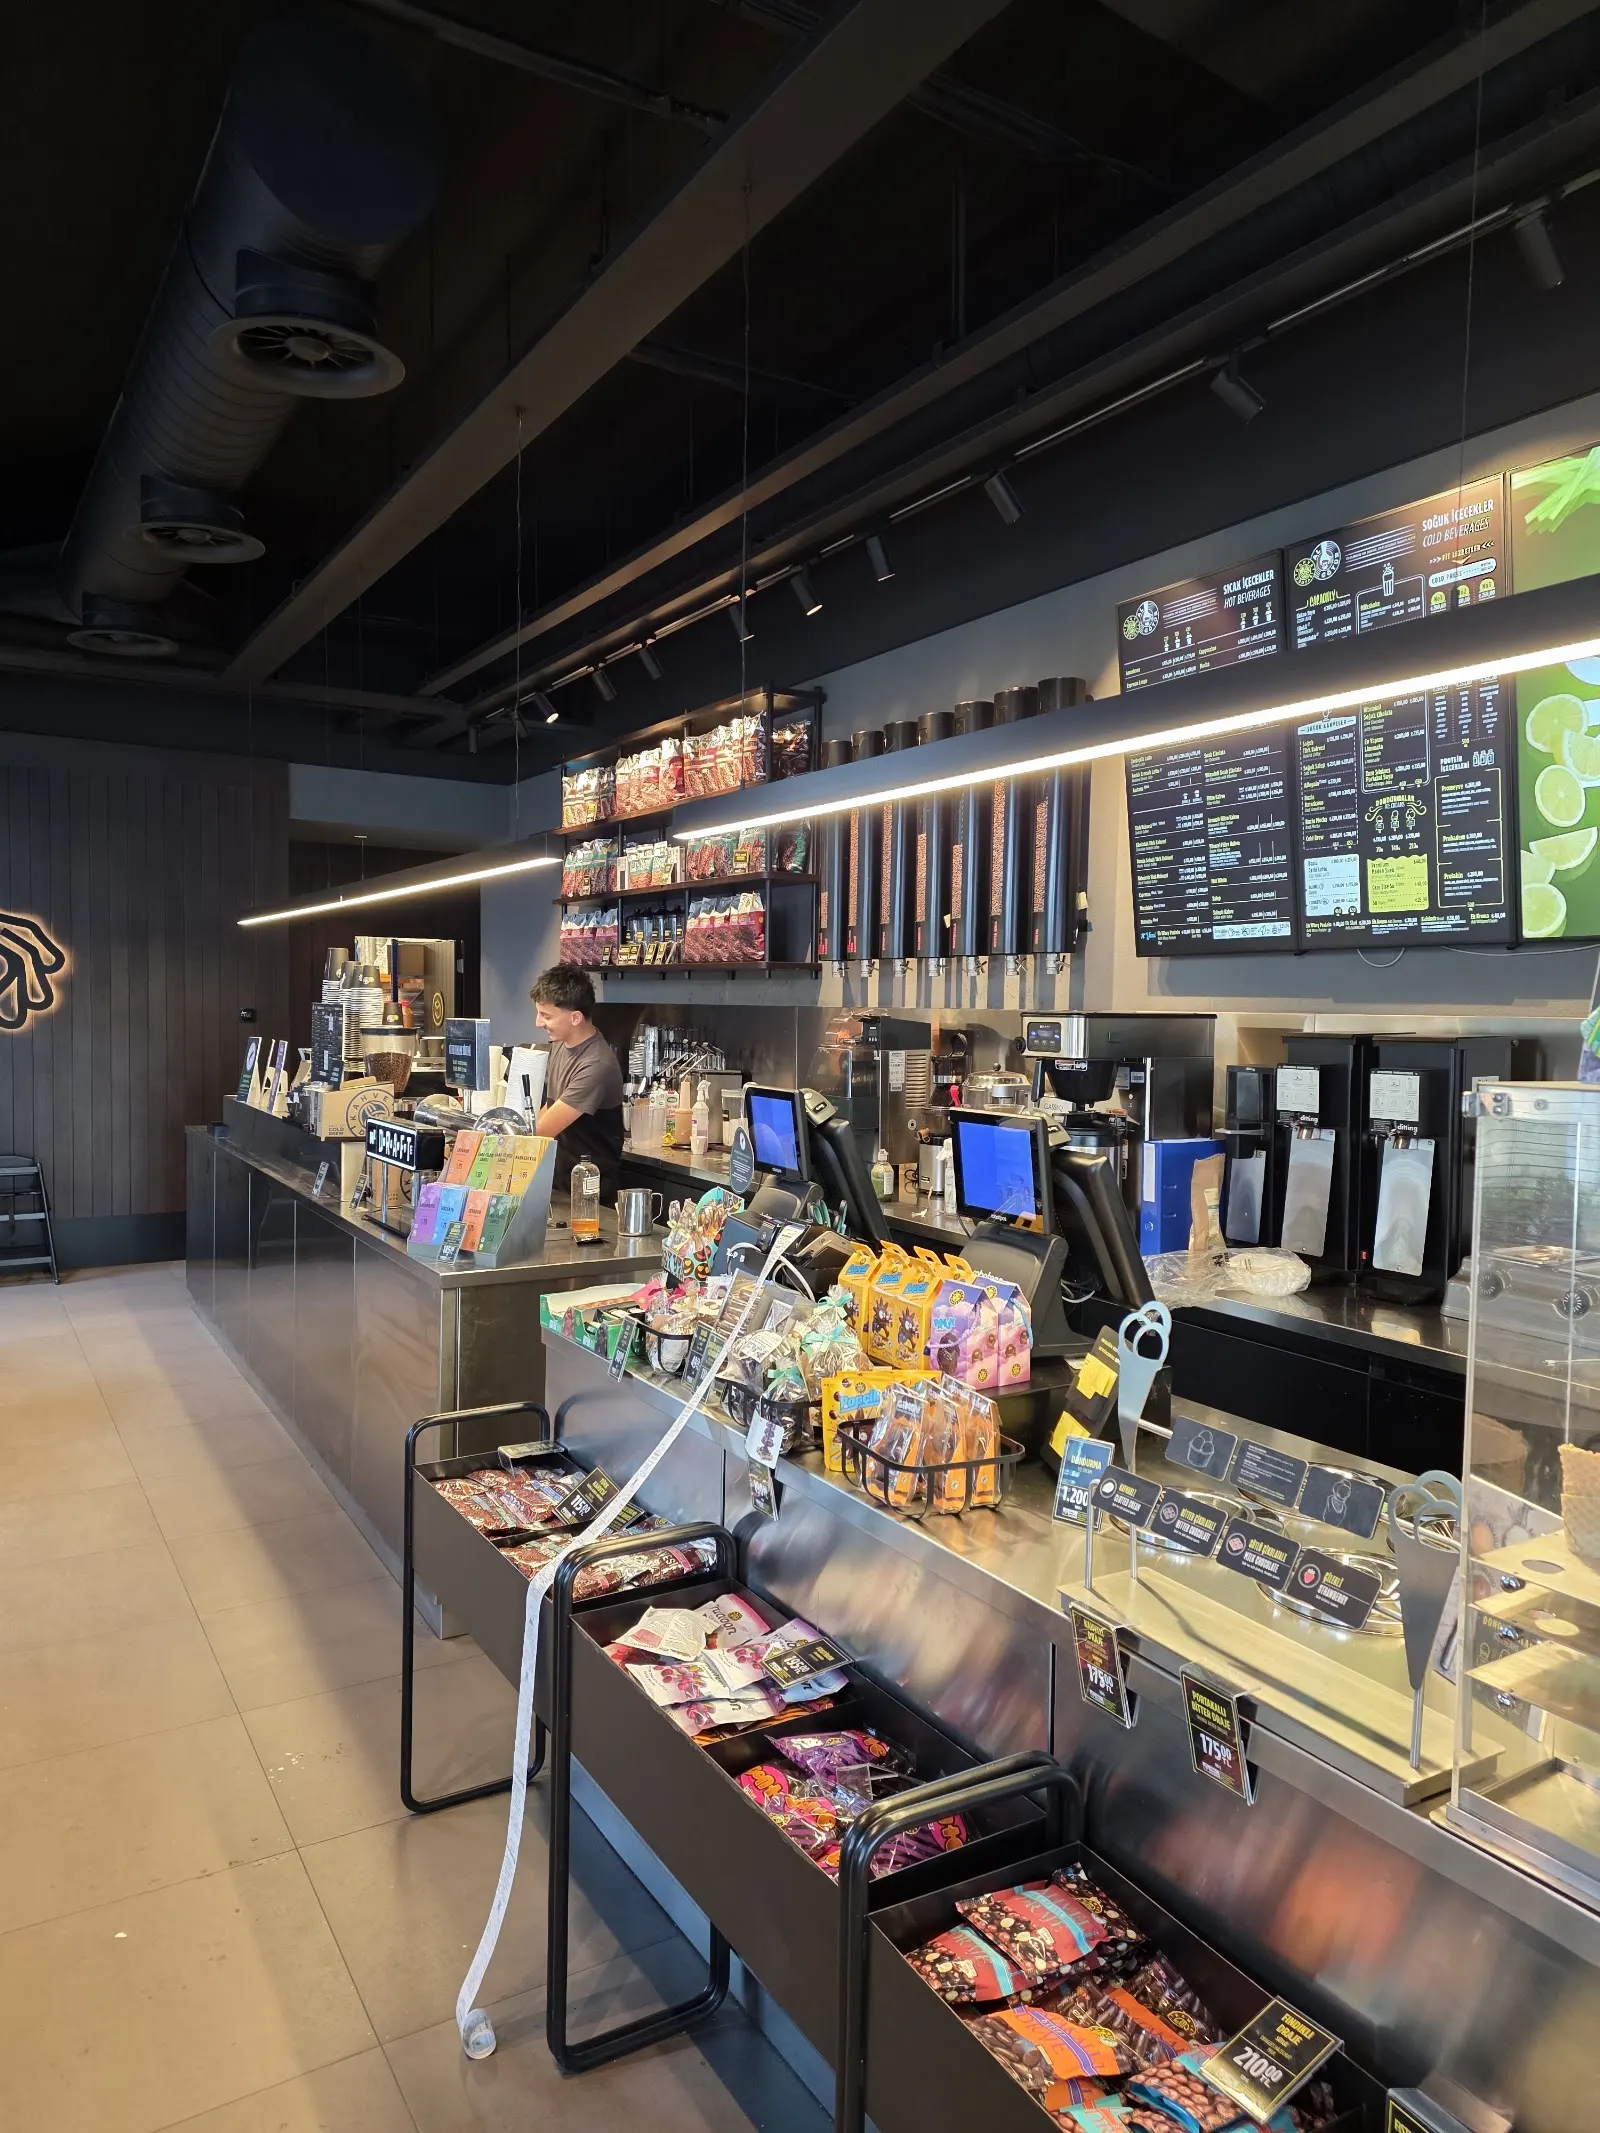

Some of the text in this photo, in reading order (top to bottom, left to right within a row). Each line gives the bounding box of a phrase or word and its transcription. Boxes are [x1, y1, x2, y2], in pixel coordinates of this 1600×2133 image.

[1422, 499, 1494, 531] SOĞUK İÇECEKLER
[1422, 517, 1490, 548] COLD BEVERAGES
[1223, 570, 1274, 595] SICAK İÇECEKLER
[1224, 594, 1236, 609] HOT
[1237, 585, 1272, 605] BEVERAGES
[1300, 1114, 1318, 1126] ditting
[1397, 1123, 1418, 1136] ditting
[1071, 1455, 1101, 1470] DONDURMA
[1189, 1525, 1211, 1542] CHOCOLATE
[1255, 1555, 1279, 1573] CHOCOLATE
[1317, 1584, 1349, 1605] STRAWBERRY
[1192, 1690, 1226, 1717] PORTAKALLI
[1191, 1701, 1231, 1730] BİTTER DRAJE
[1222, 1757, 1232, 1768] TL
[1276, 2024, 1303, 2046] DRAJE
[1281, 2013, 1316, 2040] FINDIKLI
[1259, 2074, 1271, 2088] TL
